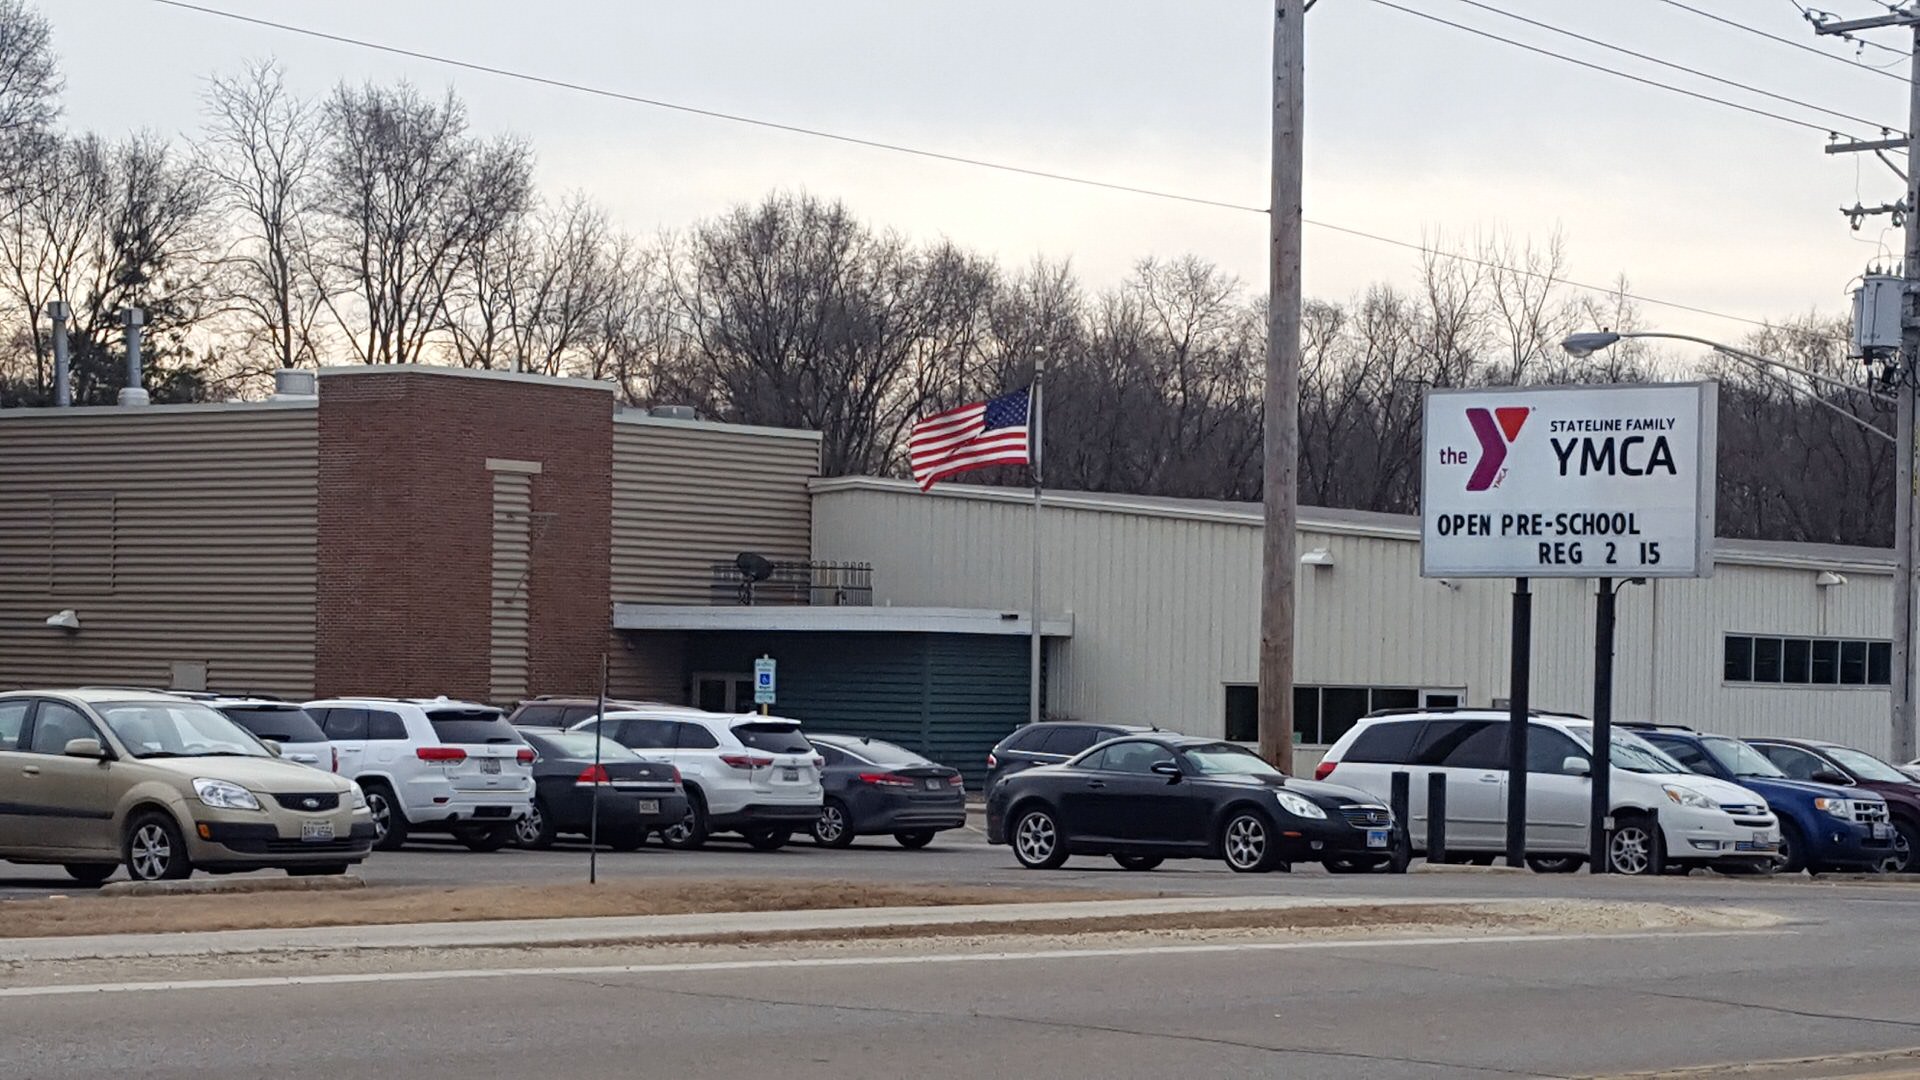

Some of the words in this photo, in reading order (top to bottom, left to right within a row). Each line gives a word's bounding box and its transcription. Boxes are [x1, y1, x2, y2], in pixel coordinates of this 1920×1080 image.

[1550, 419, 1622, 432] STATELINE
[1625, 417, 1676, 431] FAMILY
[1439, 446, 1468, 465] the
[1549, 435, 1677, 476] YMCA
[1437, 514, 1491, 536] OPEN
[1501, 512, 1641, 536] PRE-SCHOOL
[1538, 542, 1583, 564] REG
[1605, 541, 1617, 564] 2
[1640, 542, 1661, 565] 15
